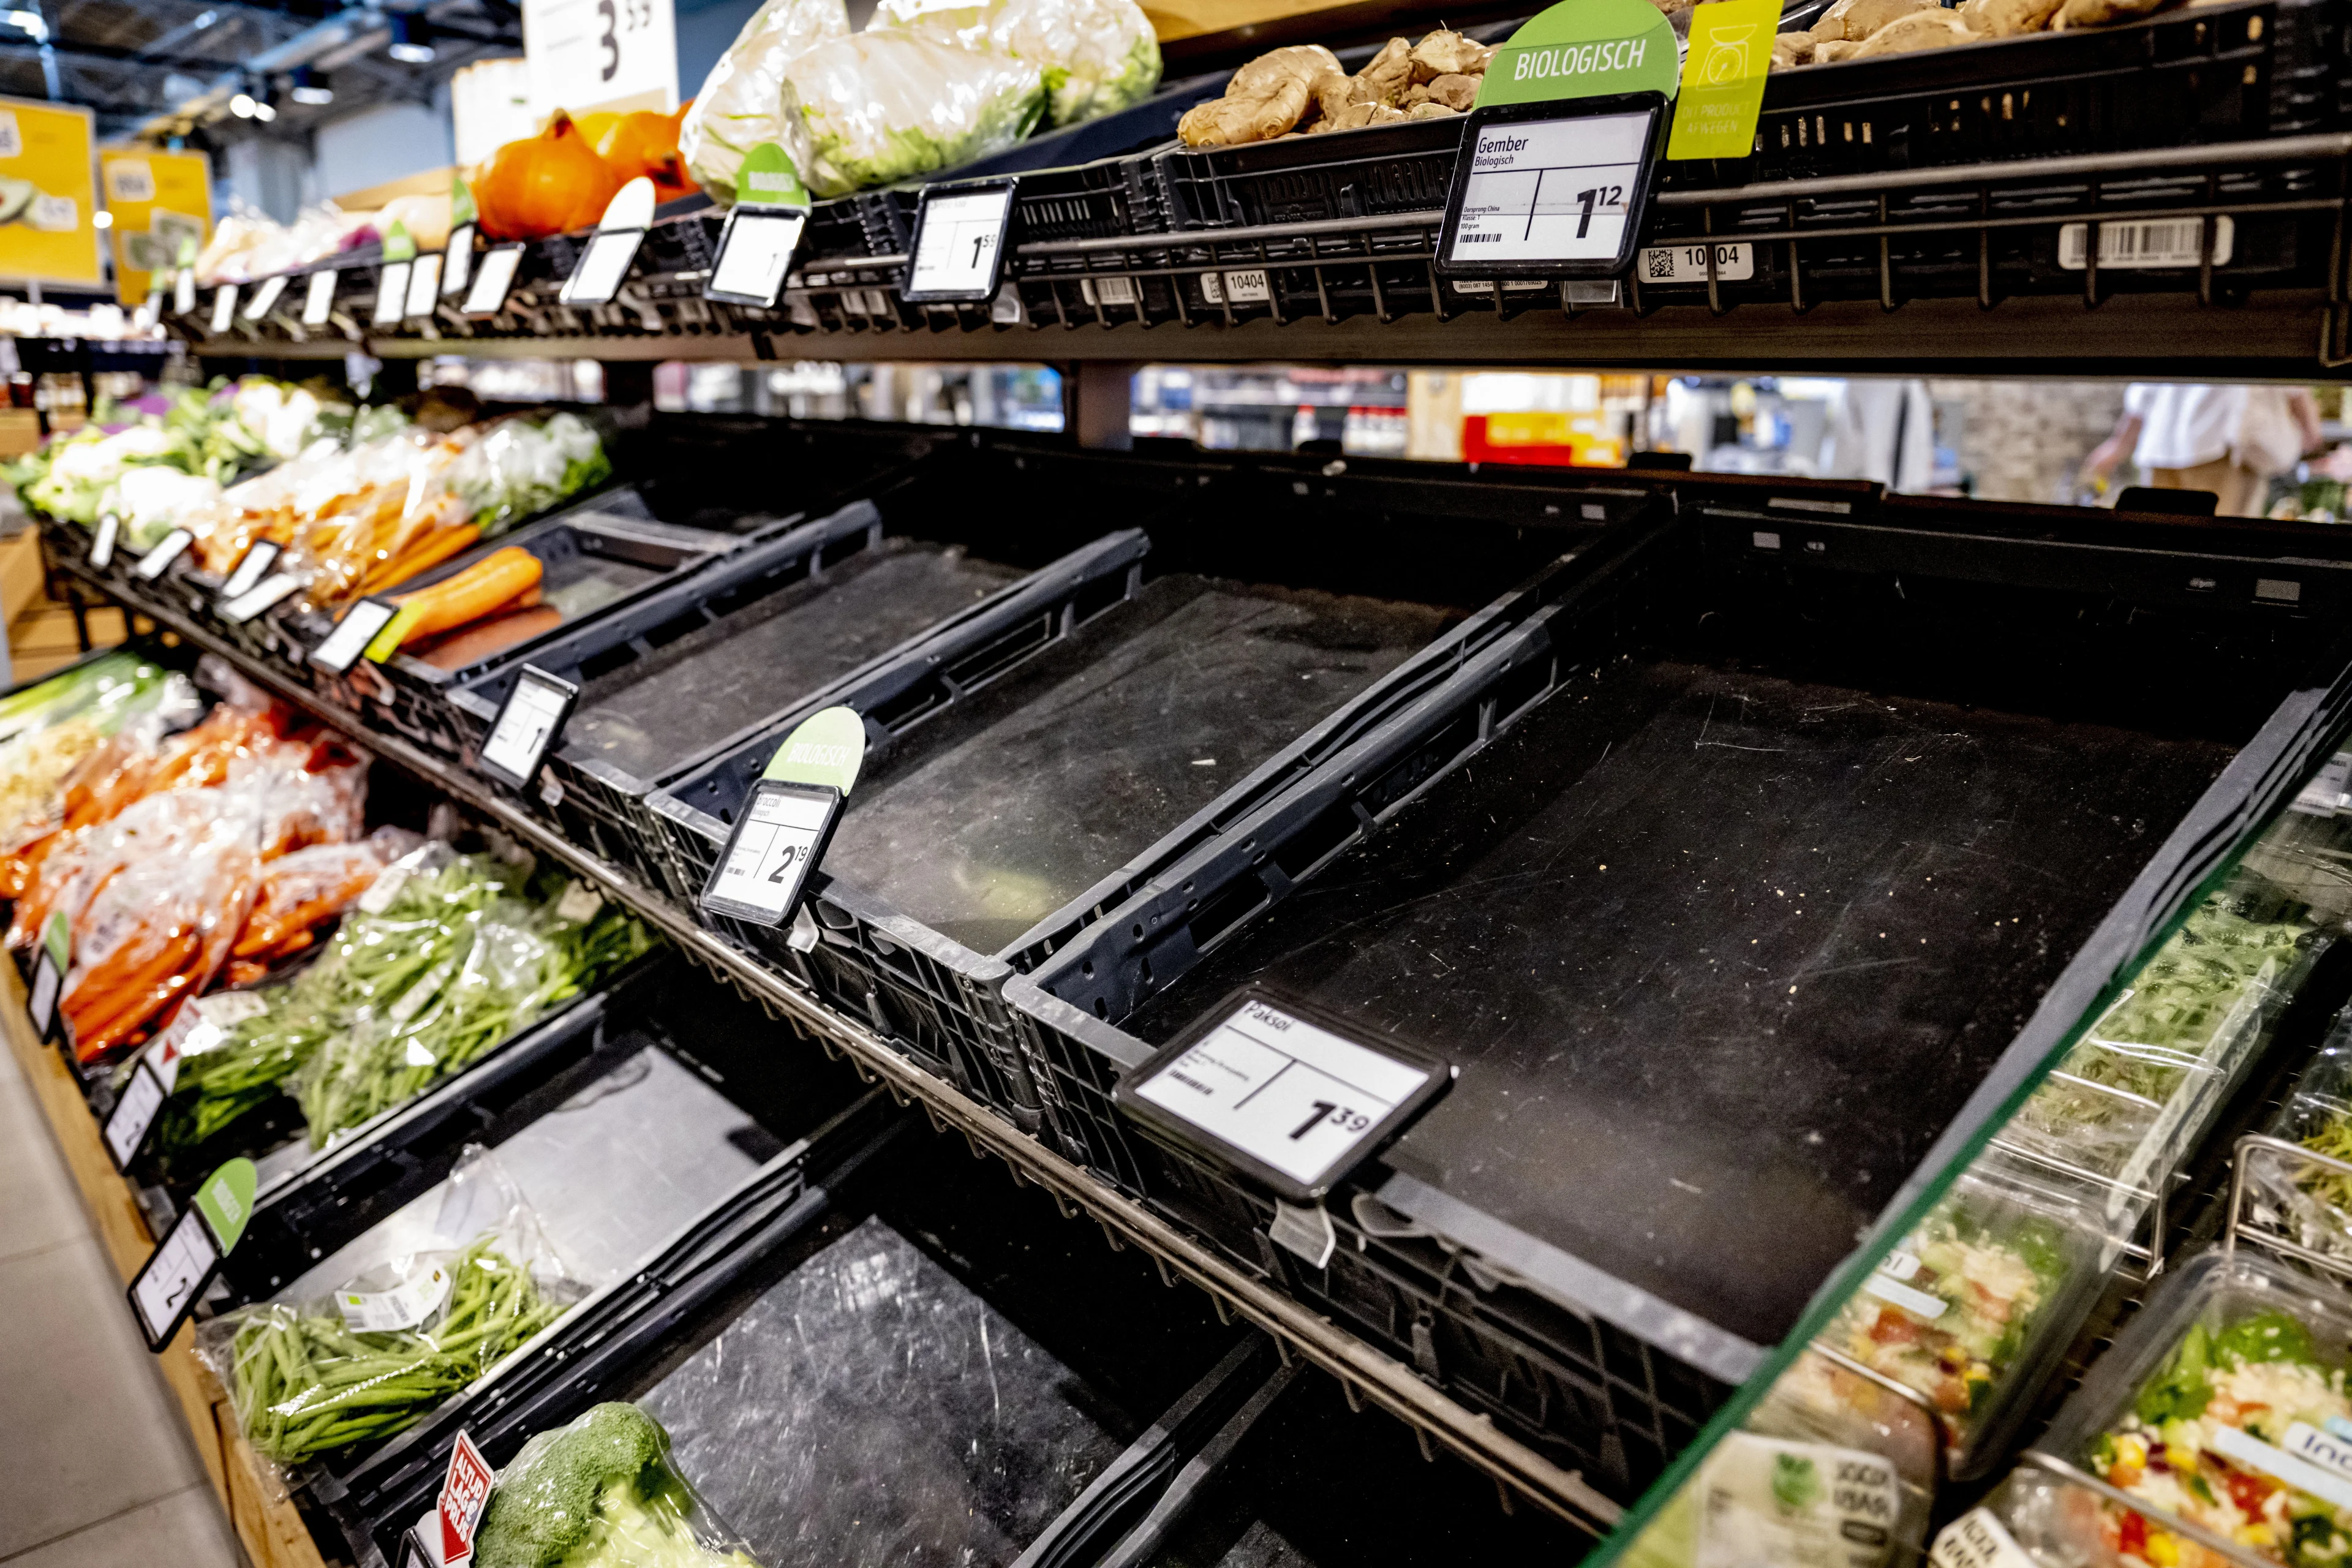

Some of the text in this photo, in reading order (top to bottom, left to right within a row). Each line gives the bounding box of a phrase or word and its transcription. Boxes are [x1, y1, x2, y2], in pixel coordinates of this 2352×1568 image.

[1514, 39, 1646, 80] BIOLOGISCH
[1479, 135, 1529, 154] Gember
[1474, 154, 1514, 168] Biologisch
[1231, 274, 1264, 289] 10404
[786, 742, 851, 767] BIOLOGISCH
[1244, 1002, 1295, 1031] Paksoi
[455, 1452, 484, 1499] ALTIJD
[449, 1469, 478, 1522] LAGE
[444, 1492, 469, 1542] PRIJS
